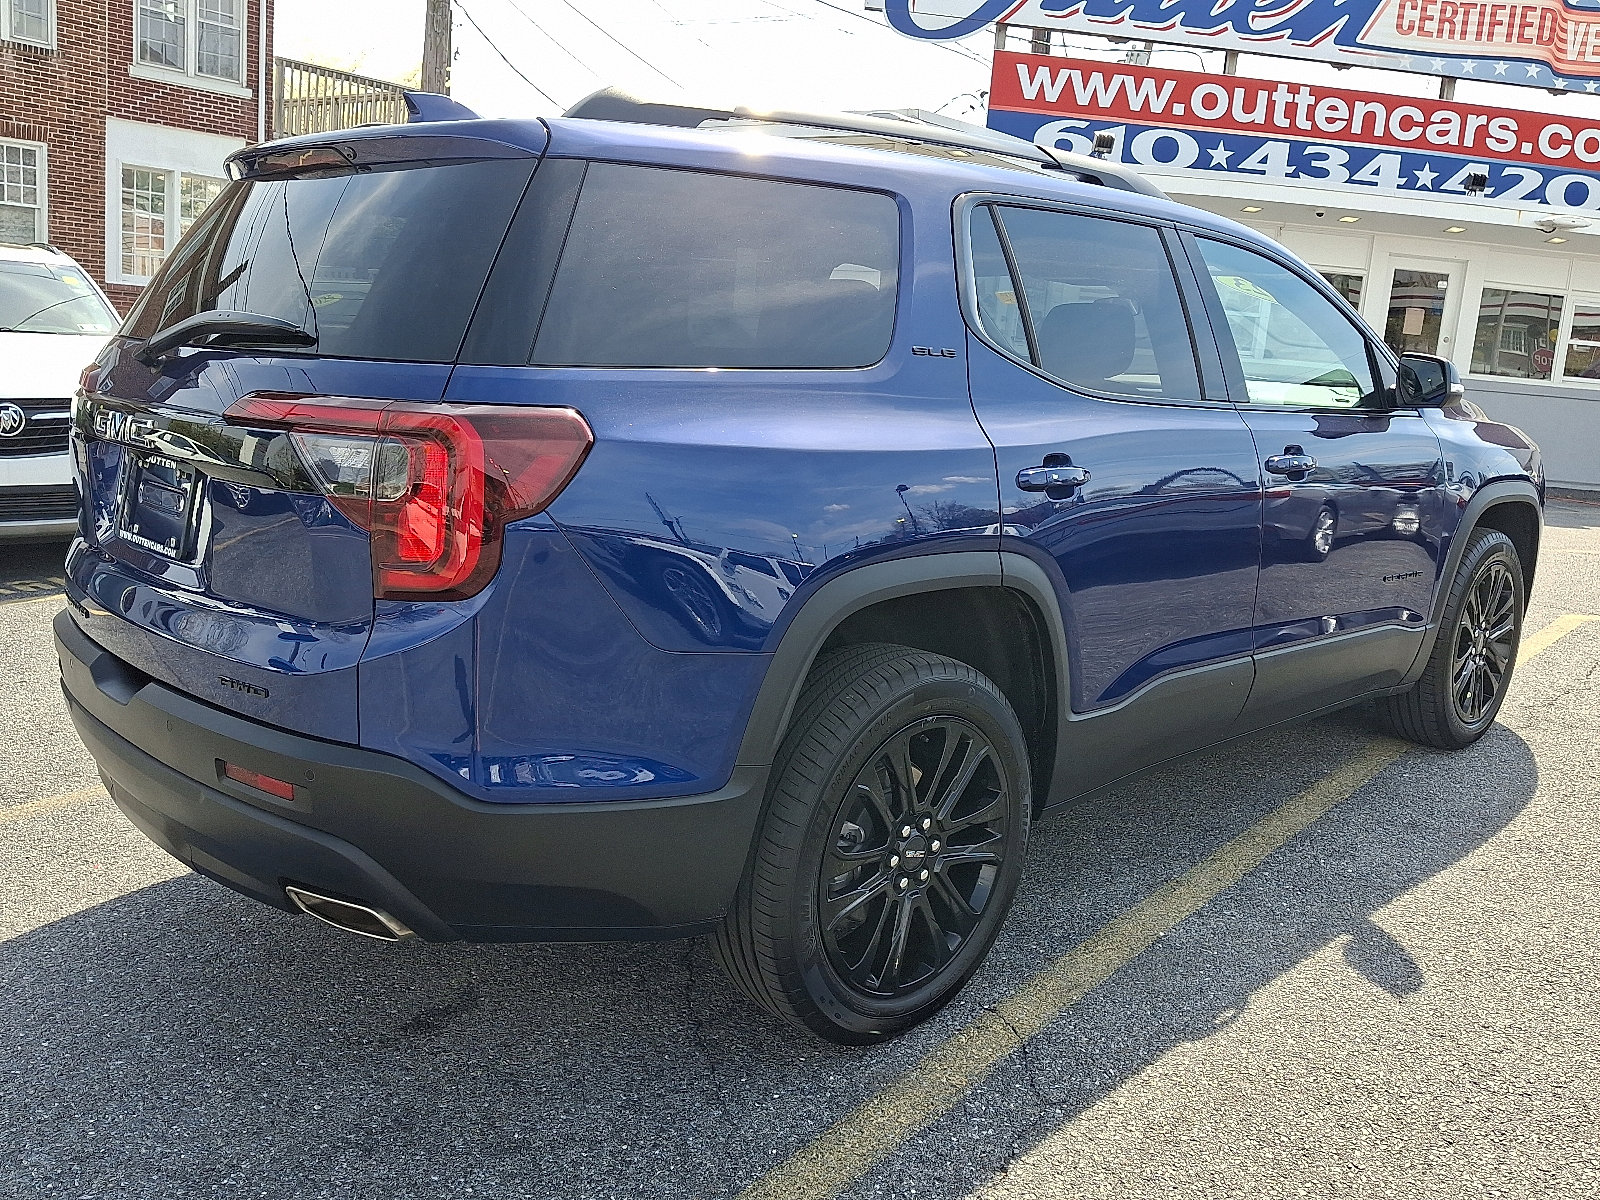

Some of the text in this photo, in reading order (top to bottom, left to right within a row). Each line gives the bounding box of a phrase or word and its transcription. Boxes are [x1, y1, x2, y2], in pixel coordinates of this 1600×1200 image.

[1395, 0, 1558, 46] CERTIFIED
[1016, 63, 1600, 163] www.outtencars.co
[1237, 140, 1407, 189] 434
[911, 345, 957, 359] SLE
[94, 409, 158, 449] GMC
